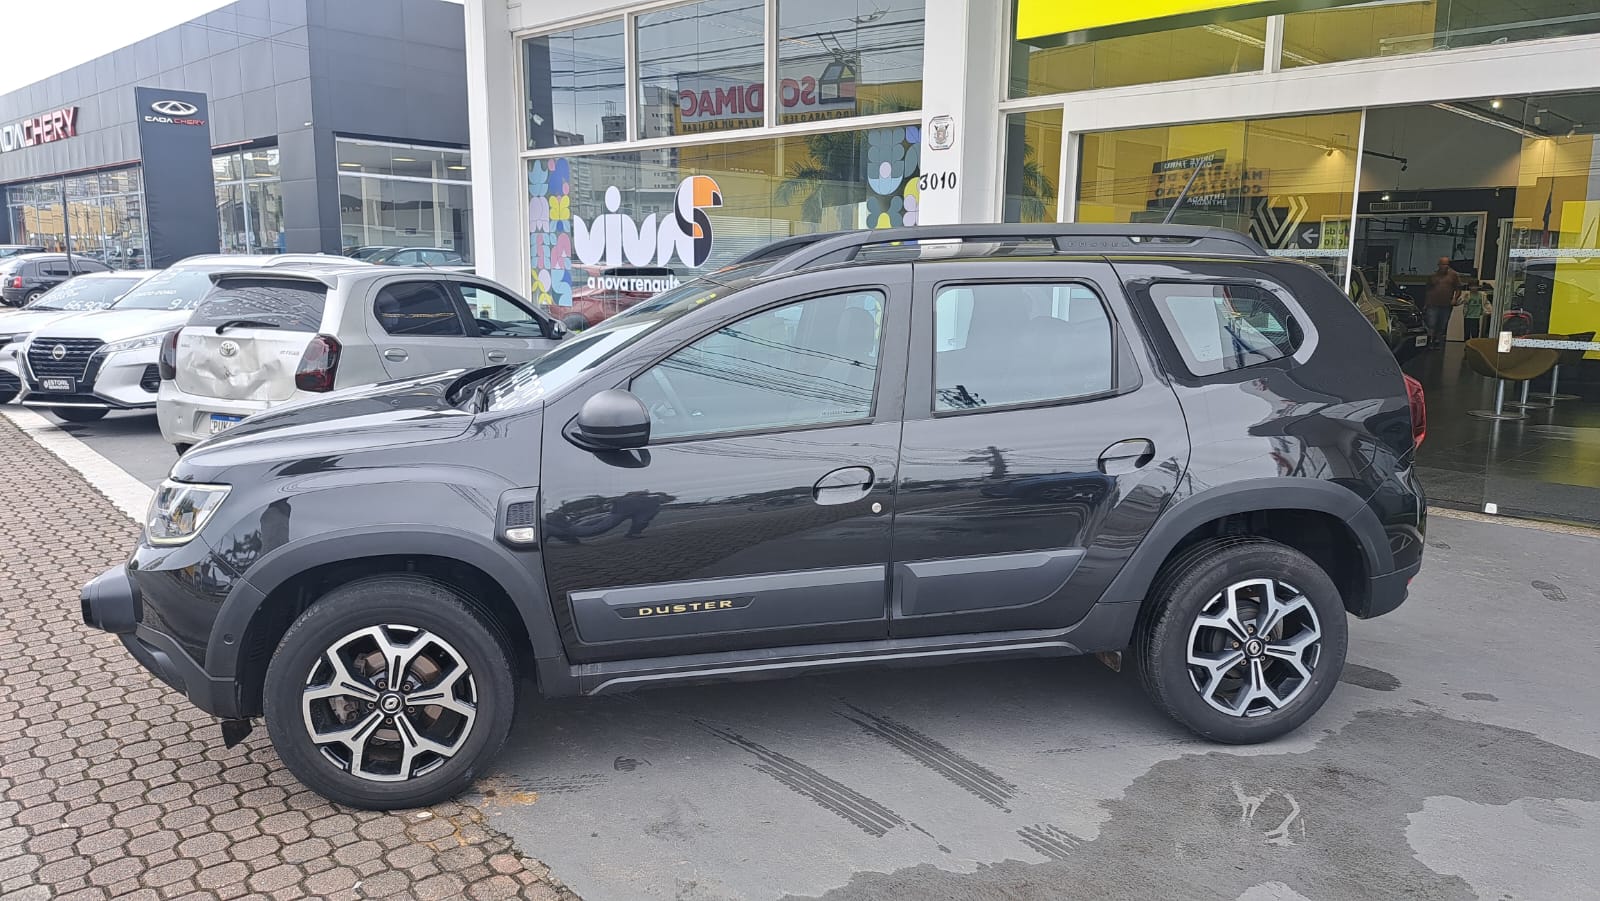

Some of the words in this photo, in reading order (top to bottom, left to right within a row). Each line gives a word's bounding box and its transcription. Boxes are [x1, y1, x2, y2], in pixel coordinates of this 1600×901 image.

[920, 172, 957, 190] 3010
[588, 277, 595, 288] a
[598, 276, 628, 290] nova
[630, 274, 681, 292] renault
[638, 600, 732, 615] DUSTER
